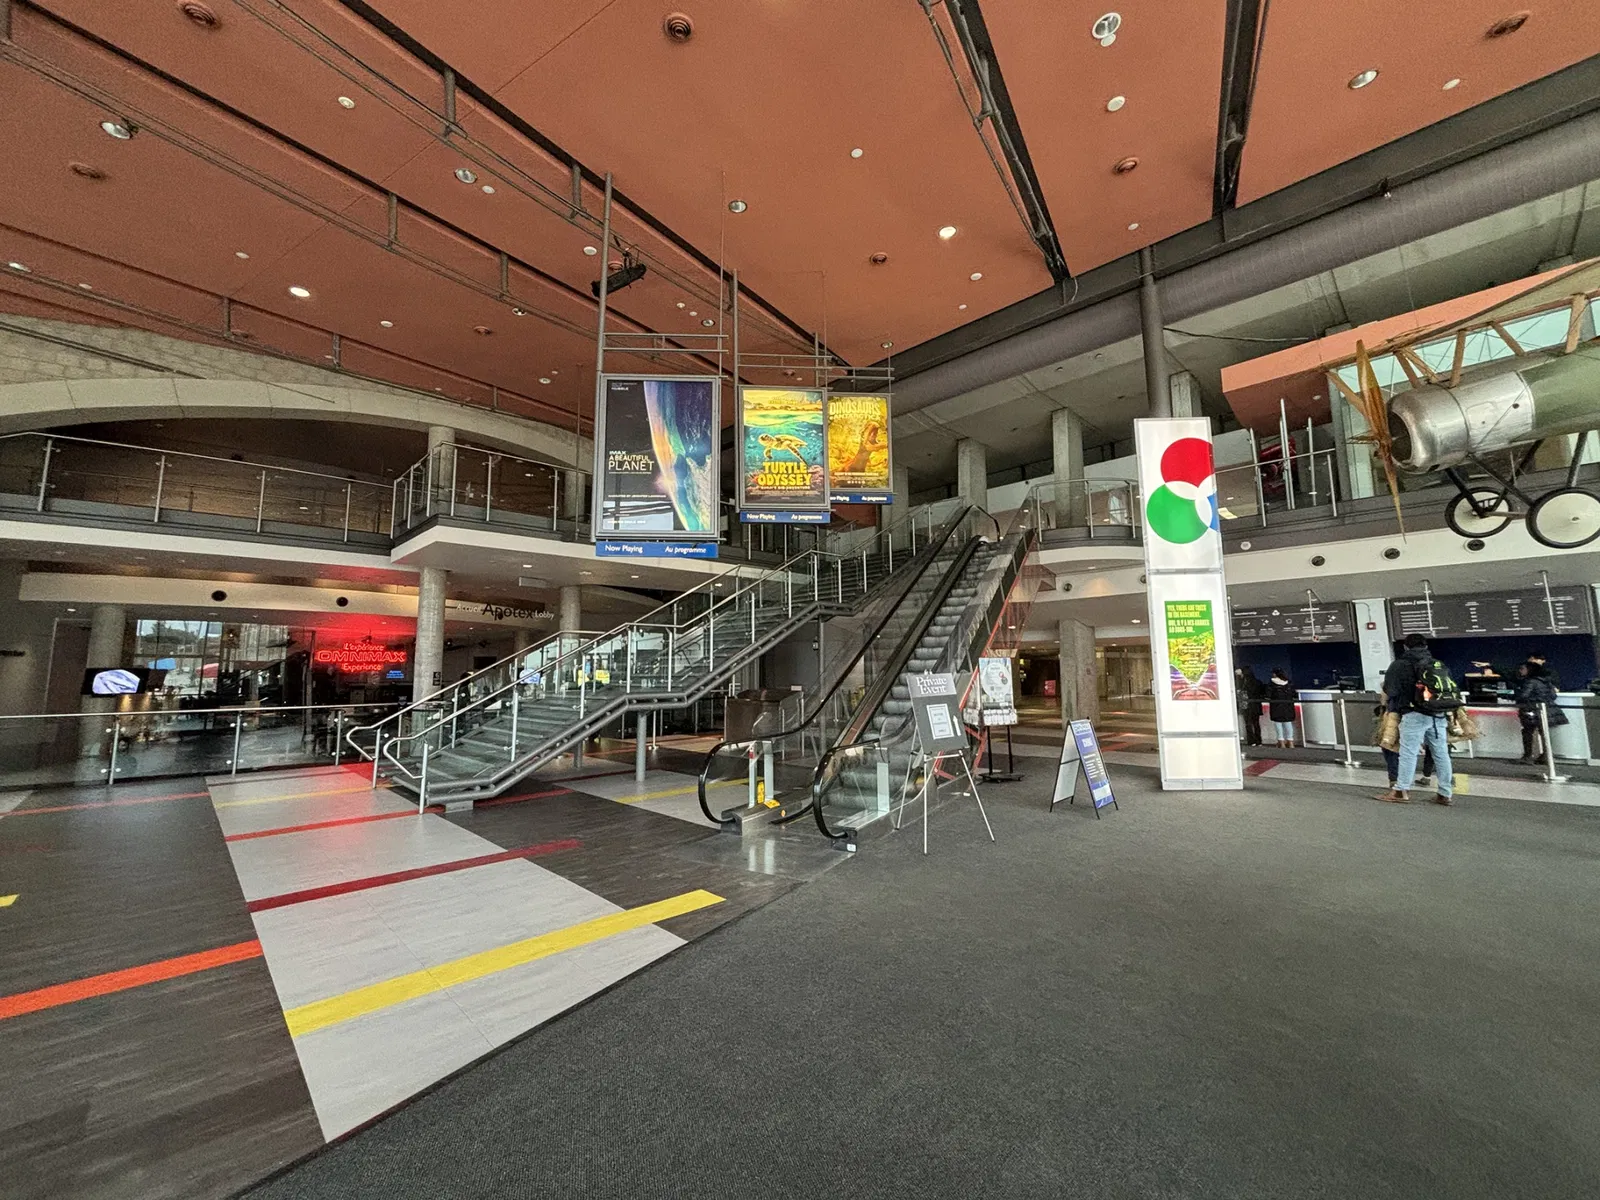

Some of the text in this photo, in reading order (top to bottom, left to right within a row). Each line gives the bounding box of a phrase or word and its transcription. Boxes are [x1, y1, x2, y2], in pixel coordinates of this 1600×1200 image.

[829, 401, 880, 415] DINOSAURS
[608, 460, 655, 471] PLANET
[762, 462, 807, 474] TURTLE
[757, 473, 812, 486] ODYSSEY
[621, 545, 644, 554] Playing
[482, 602, 533, 621] Apotex
[534, 610, 555, 620] Lobby
[317, 650, 406, 662] OMNIMAX
[915, 677, 947, 687] Private
[919, 685, 947, 694] Event
